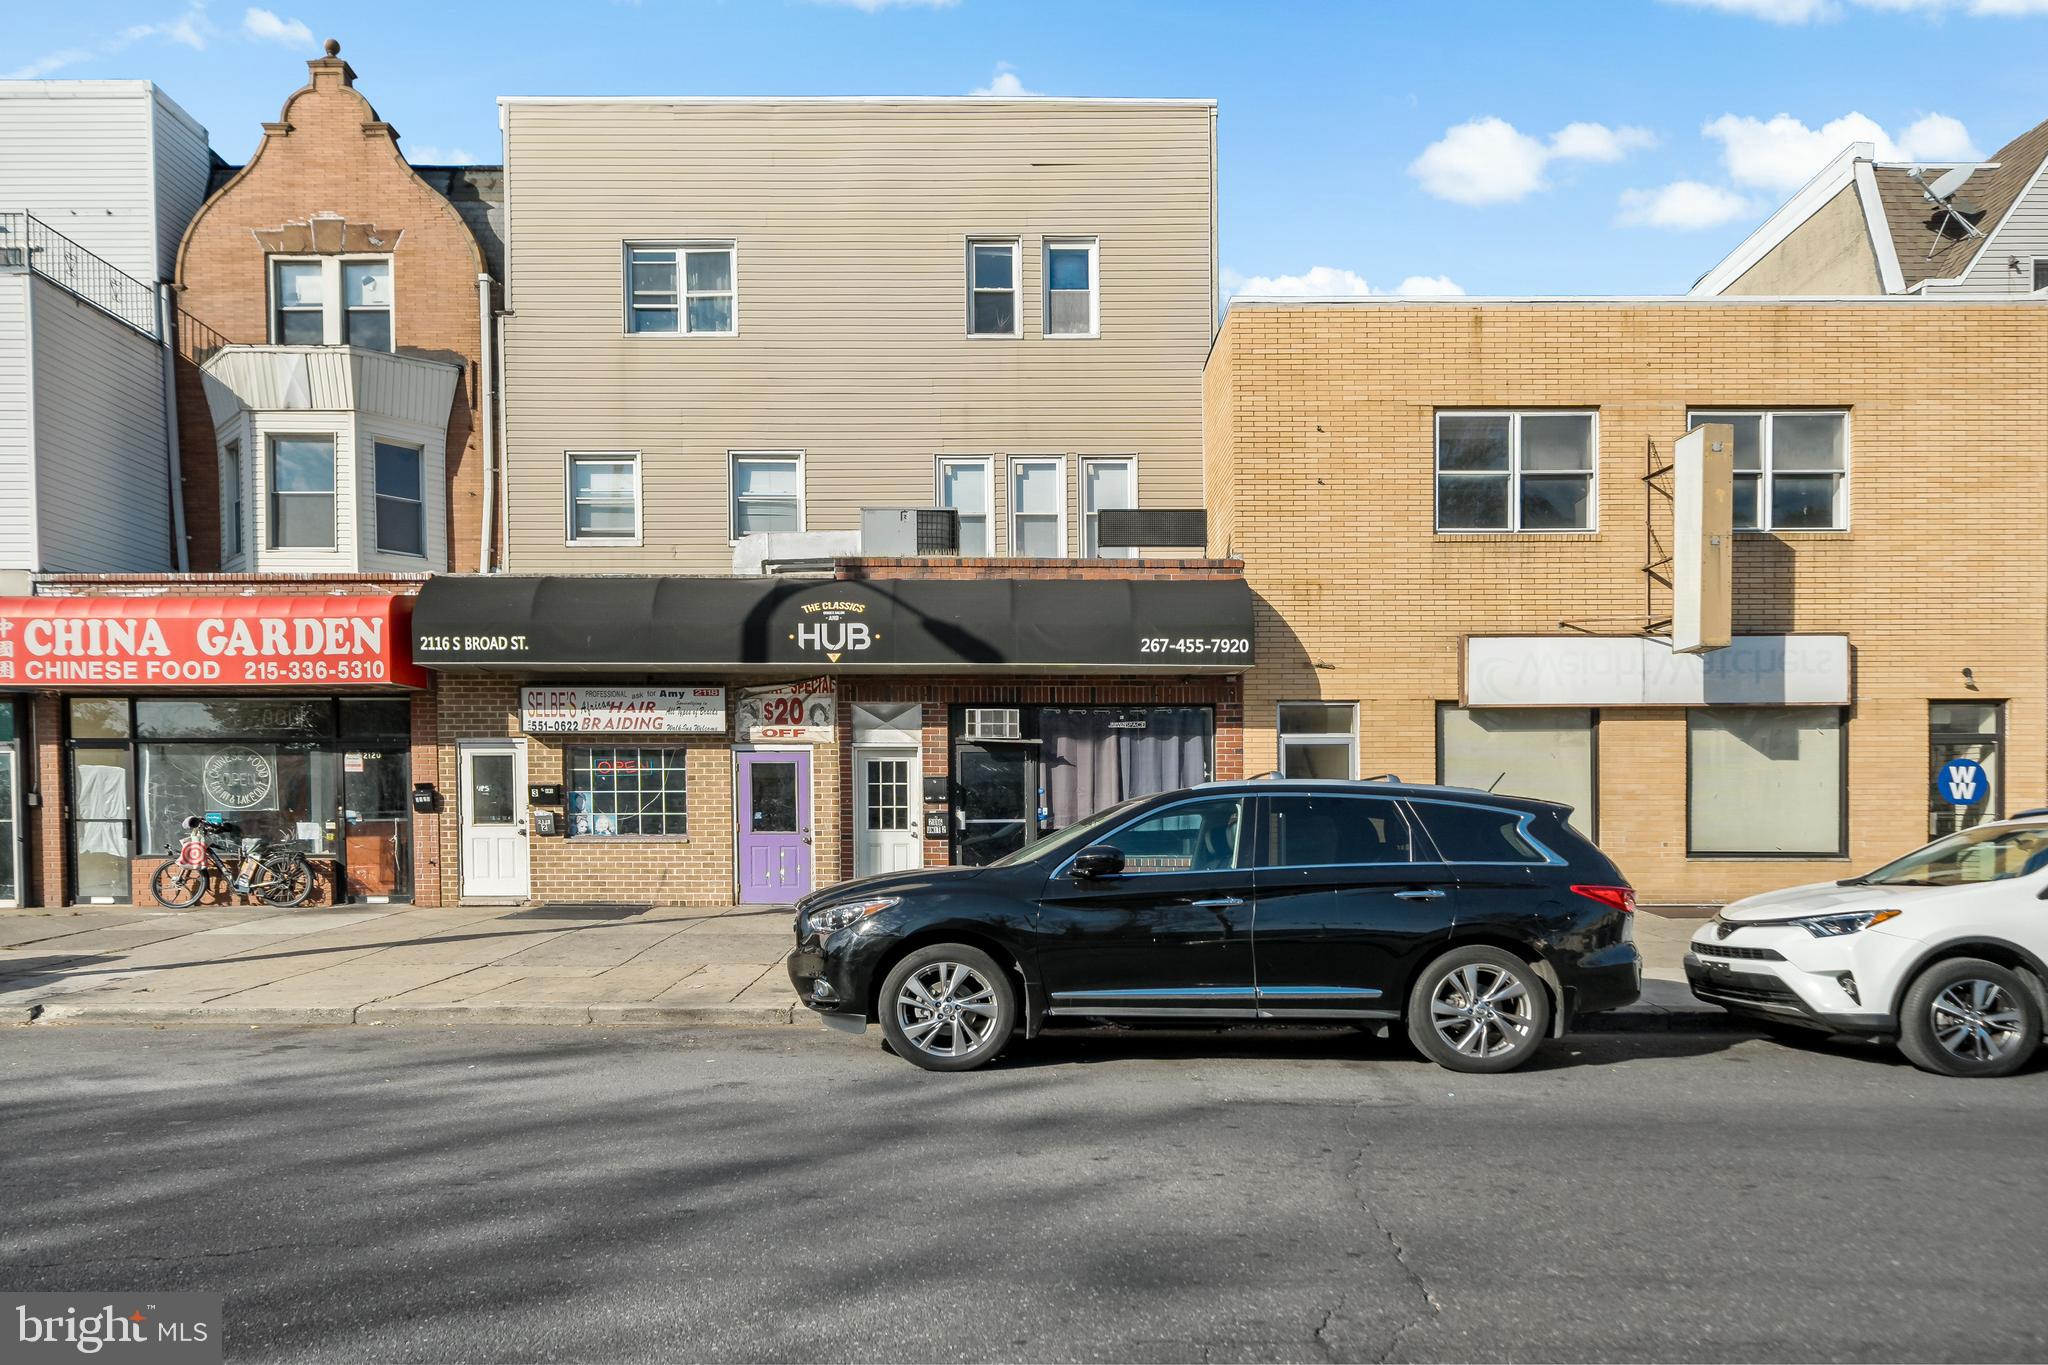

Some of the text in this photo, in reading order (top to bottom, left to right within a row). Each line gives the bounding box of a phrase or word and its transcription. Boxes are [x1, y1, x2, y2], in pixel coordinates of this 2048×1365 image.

[801, 601, 865, 613] THE CLASSICS
[24, 617, 383, 657] CHINA GARDEN
[420, 636, 529, 650] 2116 S BROAD ST.
[798, 622, 871, 650] HUB
[1140, 638, 1250, 653] 267-455-7920
[25, 660, 385, 680] CHINESE FOOD 215-336-5310
[660, 689, 684, 699] Amy
[528, 691, 576, 718] SELBE'S
[609, 701, 656, 714] HAIR
[764, 697, 804, 725] $20
[532, 720, 578, 731] 551-0622
[581, 717, 664, 730] BRAIDING
[762, 728, 806, 738] OFF
[247, 754, 269, 778] FOOD
[598, 760, 650, 774] OPEN
[222, 772, 256, 787] OPEN
[532, 789, 538, 798] 3
